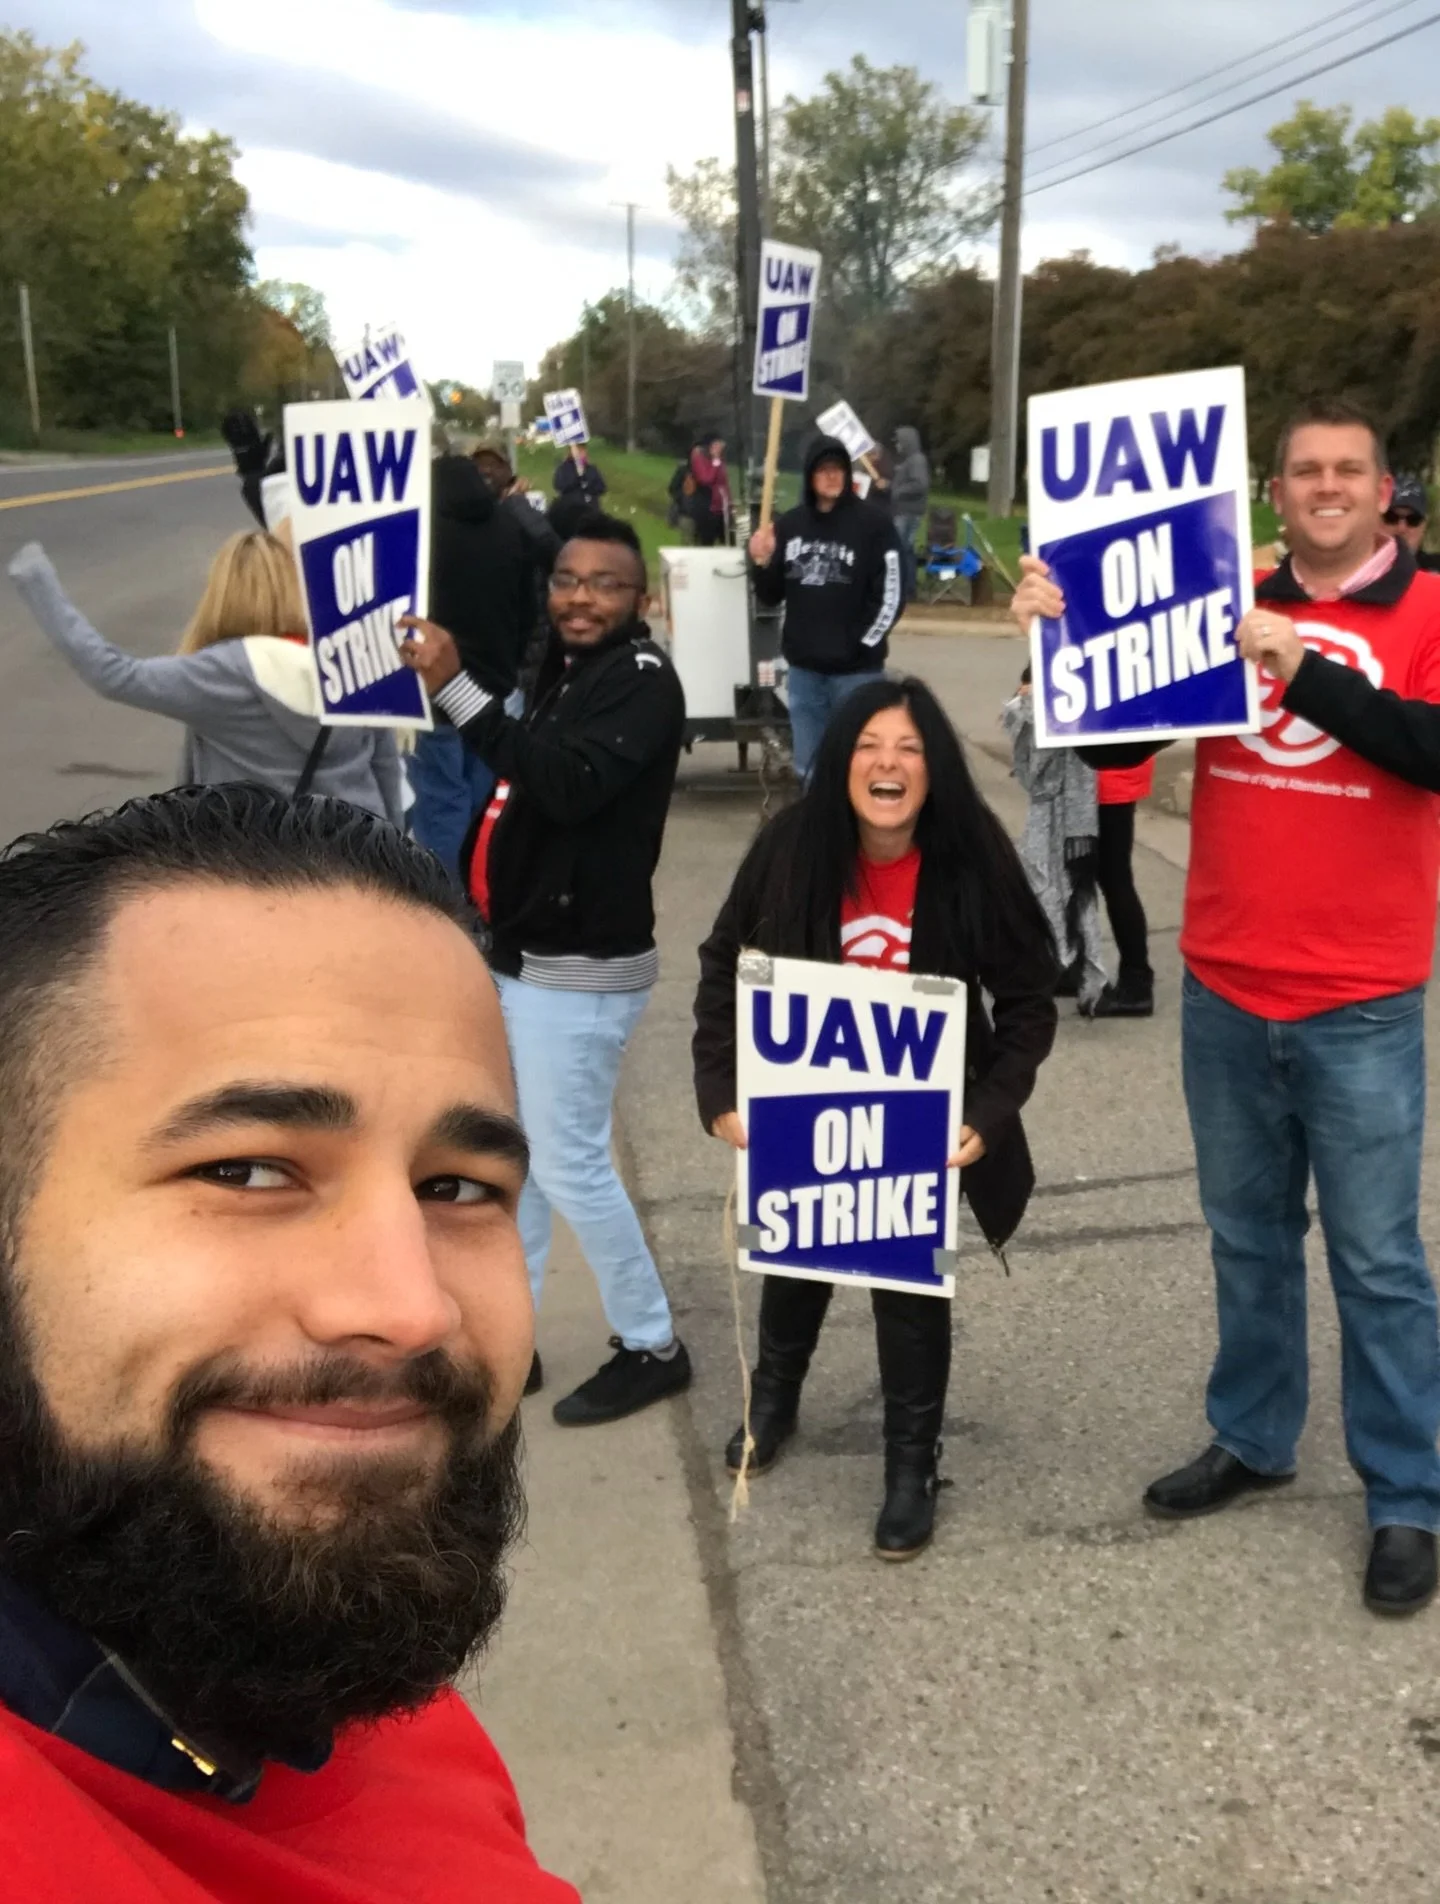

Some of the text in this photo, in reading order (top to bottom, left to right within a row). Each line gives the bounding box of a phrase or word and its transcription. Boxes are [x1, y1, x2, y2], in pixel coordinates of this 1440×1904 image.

[767, 257, 814, 296] UAW
[343, 333, 400, 381] UAW
[294, 429, 417, 506] UAW
[1040, 404, 1227, 503] UAW
[332, 532, 376, 616] ON
[1101, 523, 1175, 619] ON
[1050, 587, 1236, 724] STRIKE
[752, 989, 948, 1082] UAW
[812, 1104, 885, 1176] ON
[757, 1172, 938, 1253] STRIKE
